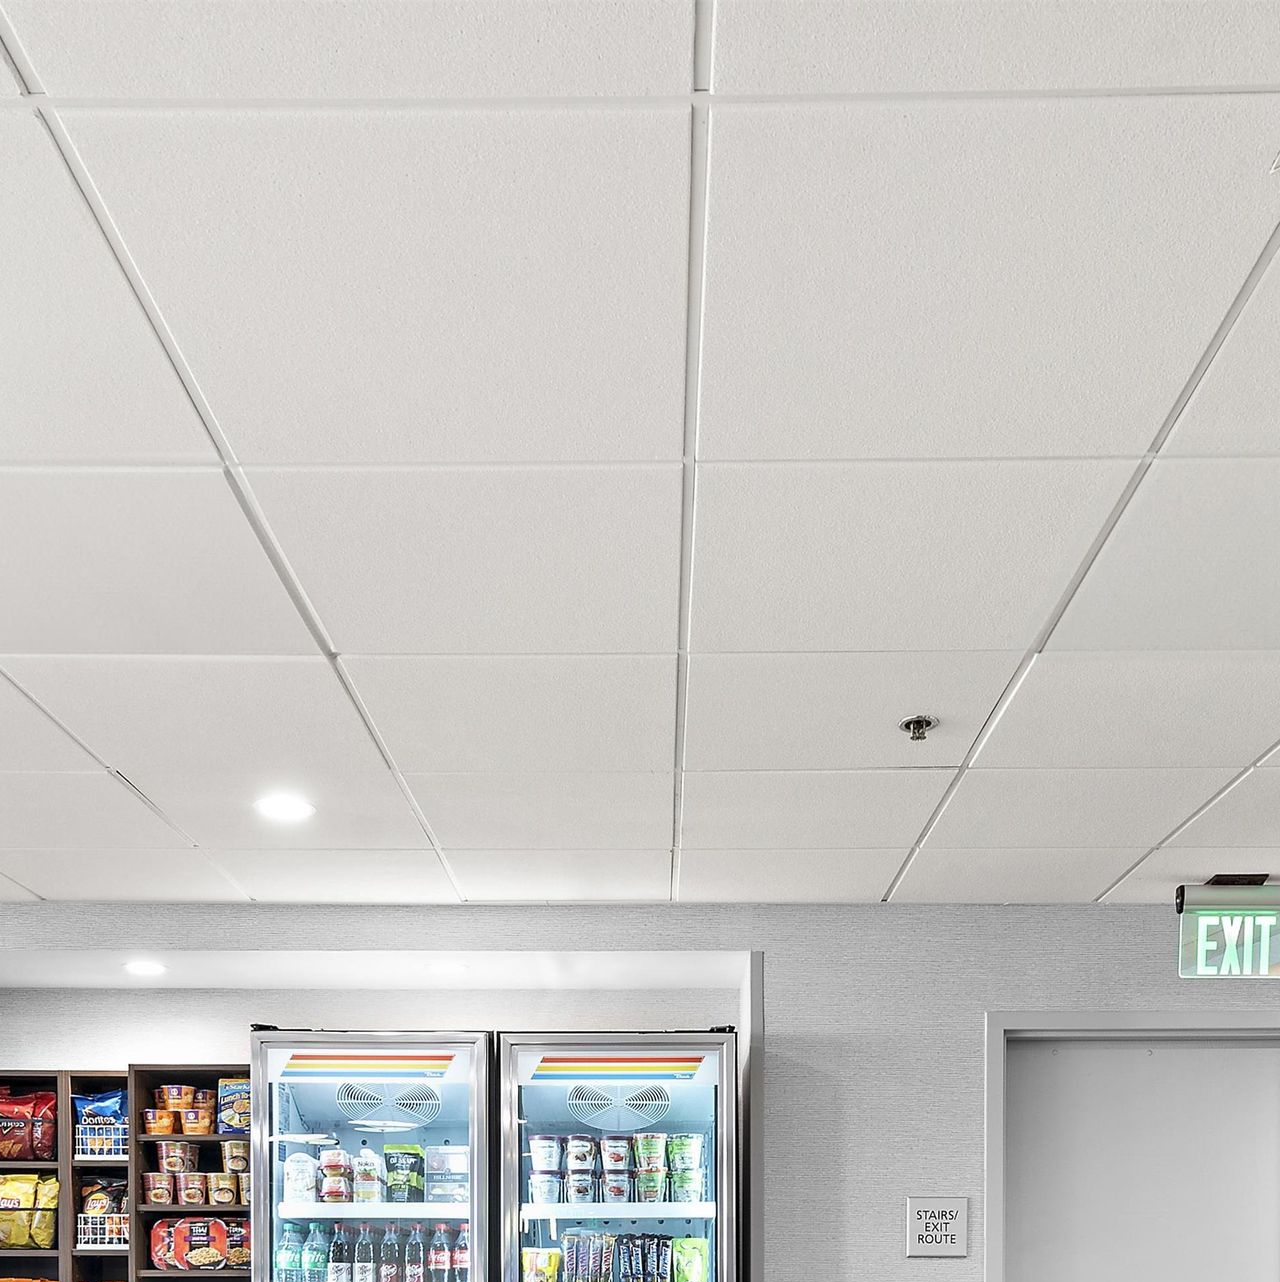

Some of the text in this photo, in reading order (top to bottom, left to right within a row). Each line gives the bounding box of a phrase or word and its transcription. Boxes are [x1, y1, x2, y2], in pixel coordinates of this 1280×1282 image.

[1197, 916, 1277, 975] EXIT
[82, 1116, 116, 1125] Doritos
[916, 1210, 958, 1220] STAIRS/
[925, 1222, 950, 1232] EXIT
[917, 1234, 956, 1244] ROUTE
